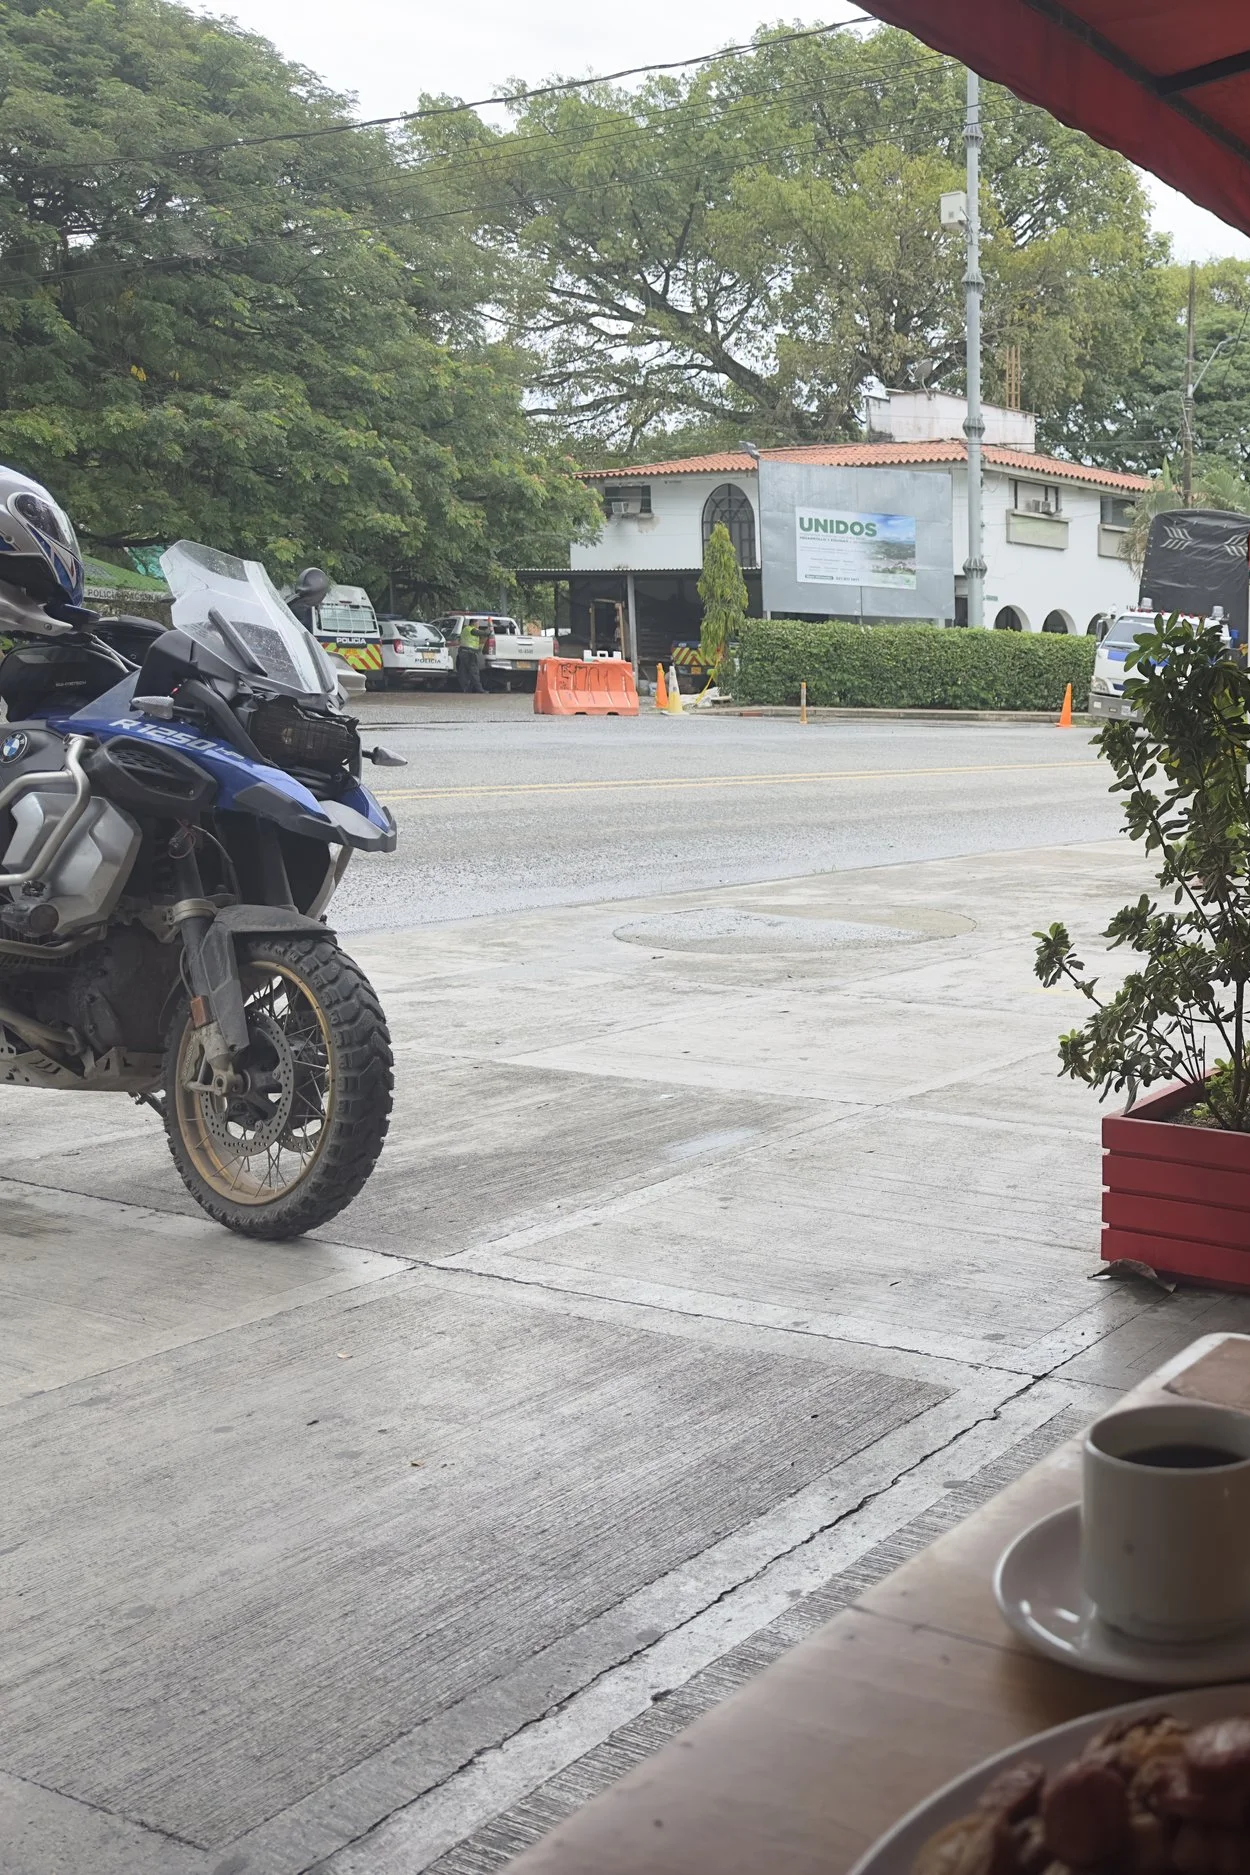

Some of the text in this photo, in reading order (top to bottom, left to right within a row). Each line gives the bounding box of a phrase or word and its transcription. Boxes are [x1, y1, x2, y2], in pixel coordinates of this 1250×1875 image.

[799, 517, 877, 537] UNIDOS
[108, 718, 142, 730] R
[137, 723, 216, 751] 1250
